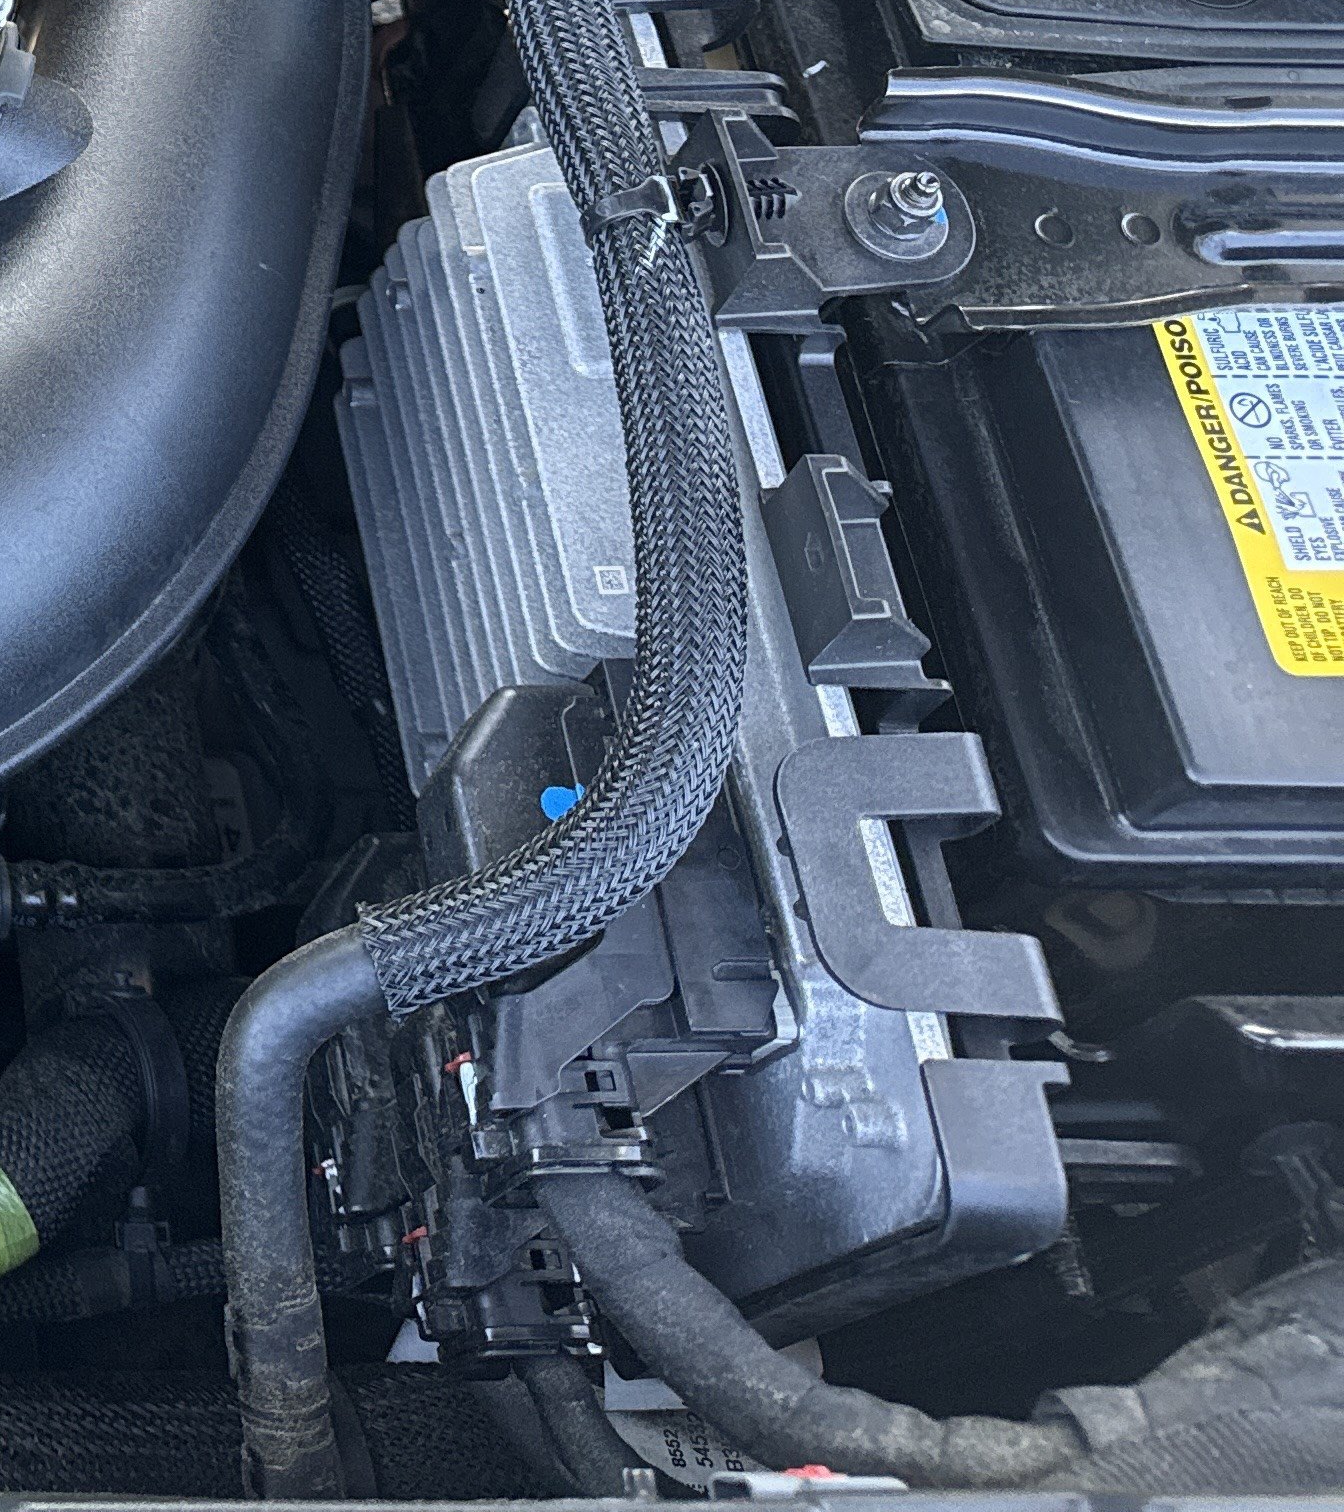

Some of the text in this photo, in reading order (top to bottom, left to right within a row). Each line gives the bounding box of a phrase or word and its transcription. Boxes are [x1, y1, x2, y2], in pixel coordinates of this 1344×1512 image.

[1202, 327, 1233, 371] SULFURIC
[1230, 350, 1253, 371] ACID
[1242, 329, 1271, 371] CAN CAUSE
[1256, 317, 1290, 370] BLINDNESS OR
[1274, 316, 1309, 371] SEVERE BURNS
[1305, 339, 1333, 371] L'ACIDE
[1264, 383, 1305, 450] SPARKS, FLAMES
[1290, 399, 1324, 450] OR SMOKING
[1265, 436, 1286, 449] NO
[1284, 526, 1312, 561] SHIELD
[1307, 536, 1332, 561] EYES
[1265, 576, 1308, 662] KEEP OUT OF REACH
[1306, 590, 1326, 608] NOT
[1313, 611, 1332, 623] DO
[1287, 587, 1328, 662] OF CHILDREN. DO
[1325, 644, 1344, 662] NOT
[663, 1428, 686, 1468] 8552
